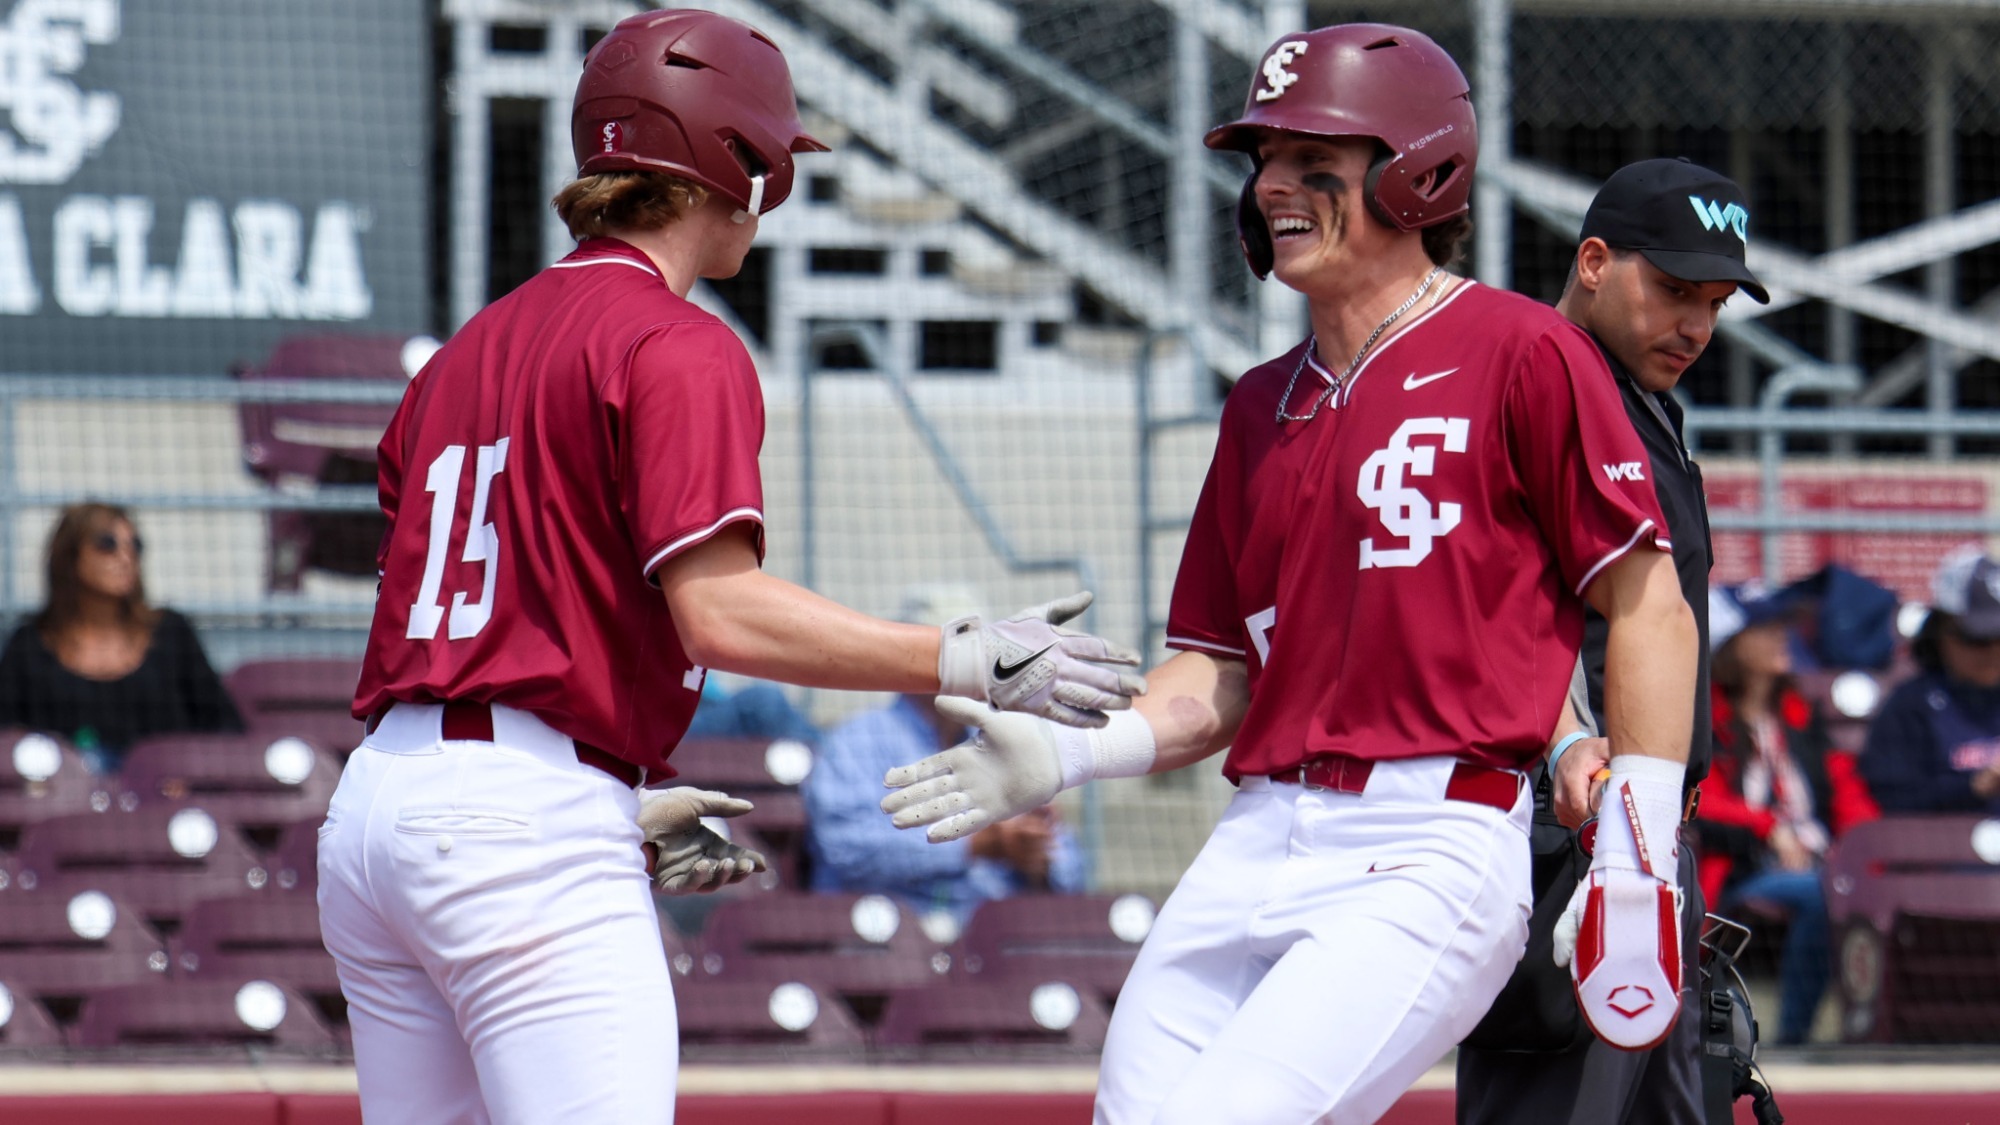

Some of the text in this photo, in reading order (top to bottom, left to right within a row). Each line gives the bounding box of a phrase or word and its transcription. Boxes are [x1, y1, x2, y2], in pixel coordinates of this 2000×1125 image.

[54, 194, 373, 320] CLARA
[1602, 461, 1646, 482] WCC
[405, 436, 510, 640] 15
[1623, 793, 1650, 863] EVOSHIELD
